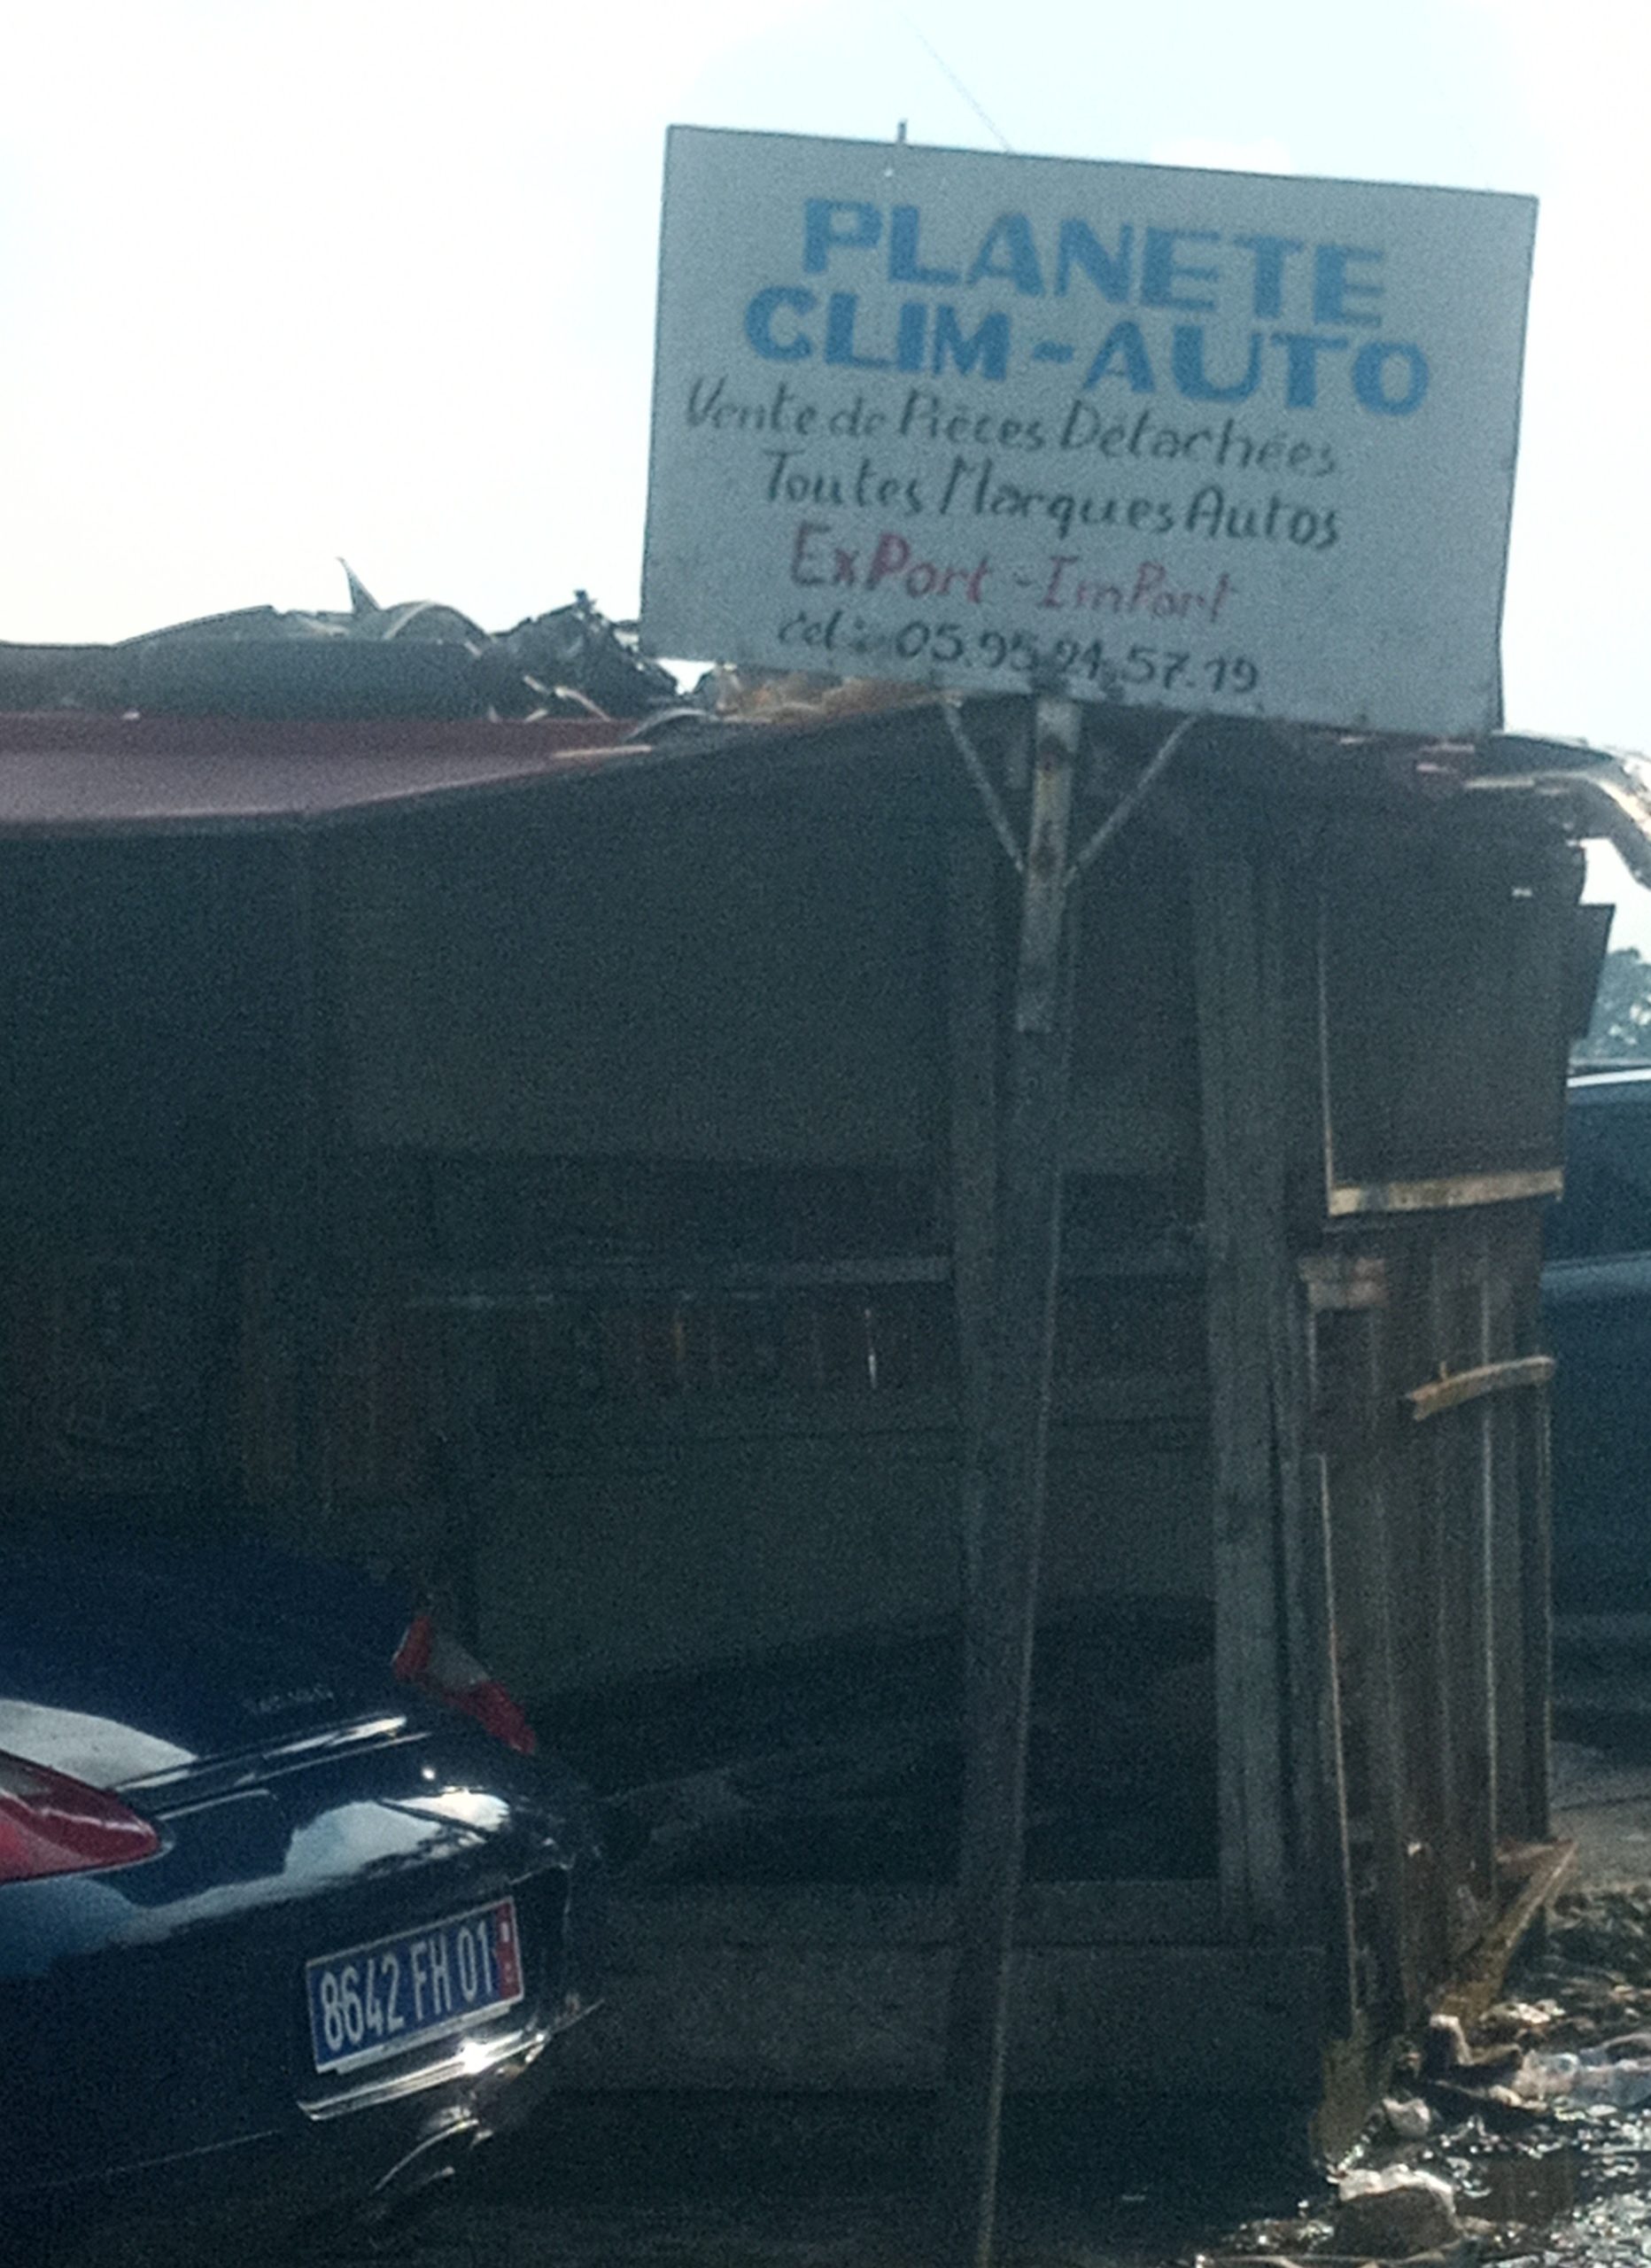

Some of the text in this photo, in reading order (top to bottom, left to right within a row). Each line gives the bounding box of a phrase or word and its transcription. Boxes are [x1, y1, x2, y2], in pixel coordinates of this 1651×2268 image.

[802, 198, 1384, 328] PLANETE
[686, 375, 817, 436] Vente
[829, 397, 886, 438] de
[745, 285, 1429, 417] CLIM-AUTO
[763, 448, 1339, 550] Toutes Marques Autos
[320, 1919, 492, 2052] 8642 FH 01
